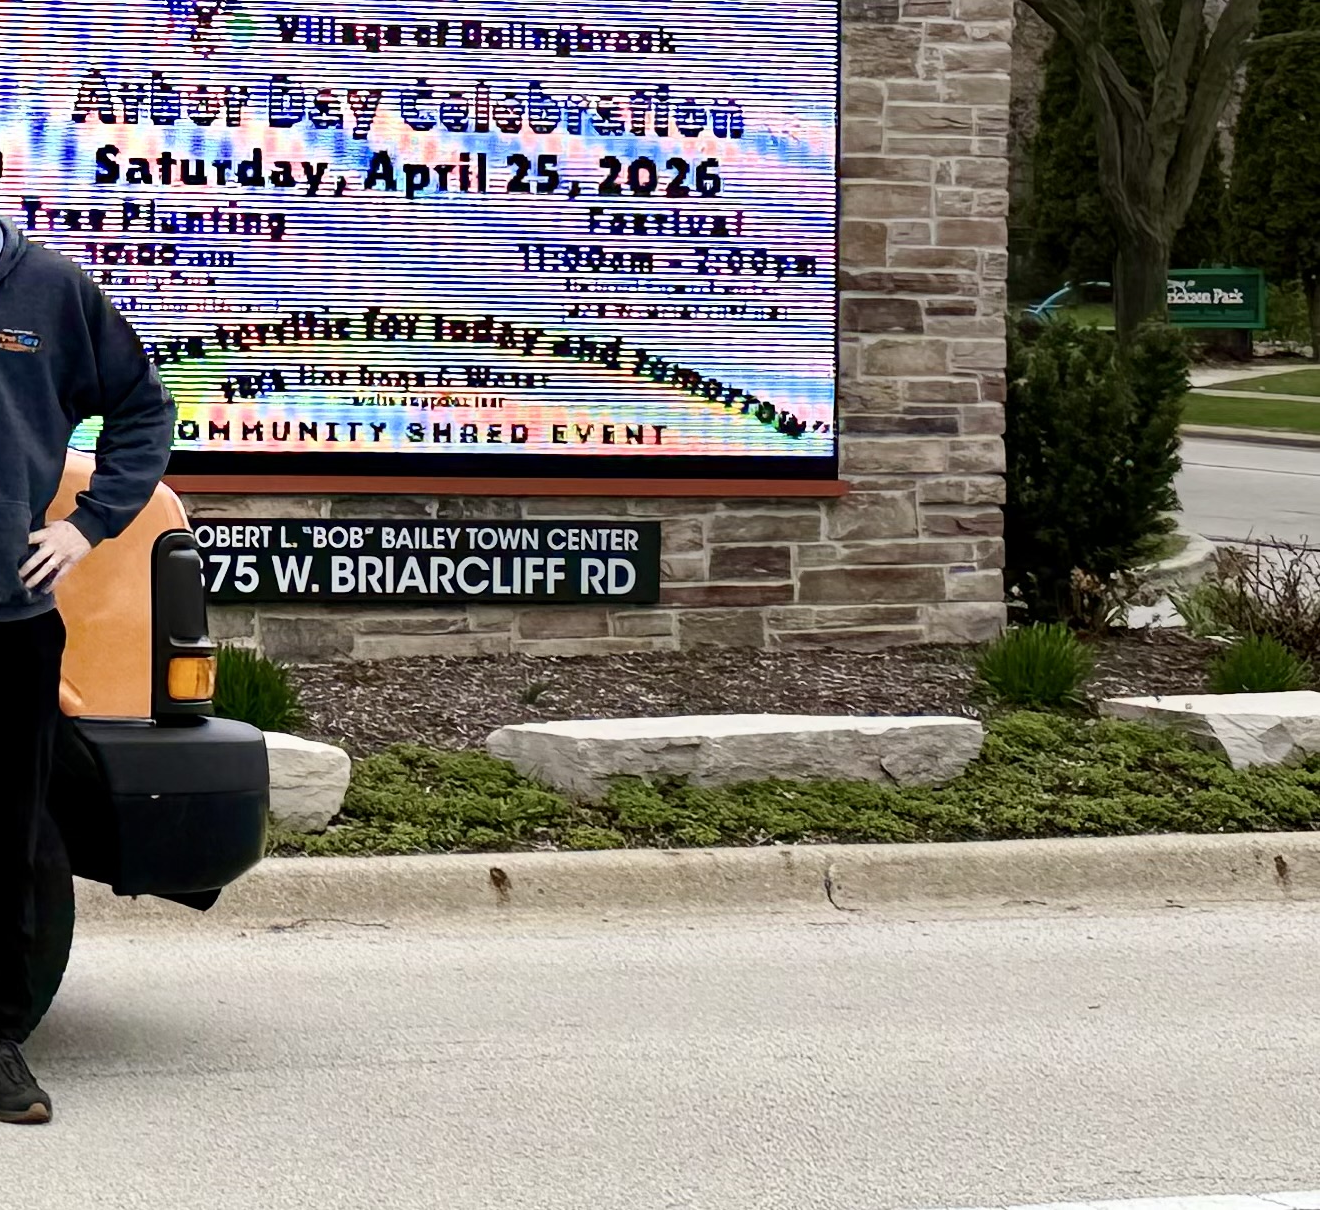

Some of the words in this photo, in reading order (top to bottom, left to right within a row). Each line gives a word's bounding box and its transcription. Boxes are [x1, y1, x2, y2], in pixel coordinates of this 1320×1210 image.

[277, 14, 403, 54] Village
[416, 18, 451, 48] of
[461, 20, 676, 56] Bolingbrook
[71, 69, 249, 128] Arbor
[267, 73, 382, 140] Day
[399, 78, 744, 138] Celebration
[94, 144, 348, 196] Saturday,
[363, 150, 487, 200] April
[507, 154, 581, 199] 25,
[599, 156, 722, 197] 2026
[122, 199, 286, 241] Planting
[587, 208, 745, 236] Festival
[363, 306, 421, 341] for
[434, 309, 545, 356] today
[552, 334, 622, 369] and
[177, 420, 386, 442] OMMUNITY
[406, 421, 529, 444] SHRED
[552, 423, 669, 445] EVENT
[194, 525, 273, 548] OBERT
[280, 526, 299, 548] L.
[302, 526, 374, 550] "BOB"
[381, 527, 462, 550] BAILEY
[466, 528, 540, 551] TOWN
[547, 528, 640, 552] CENTER
[271, 555, 321, 594] W.
[331, 556, 568, 596] BRIARCLIFF
[579, 558, 638, 595] RD
